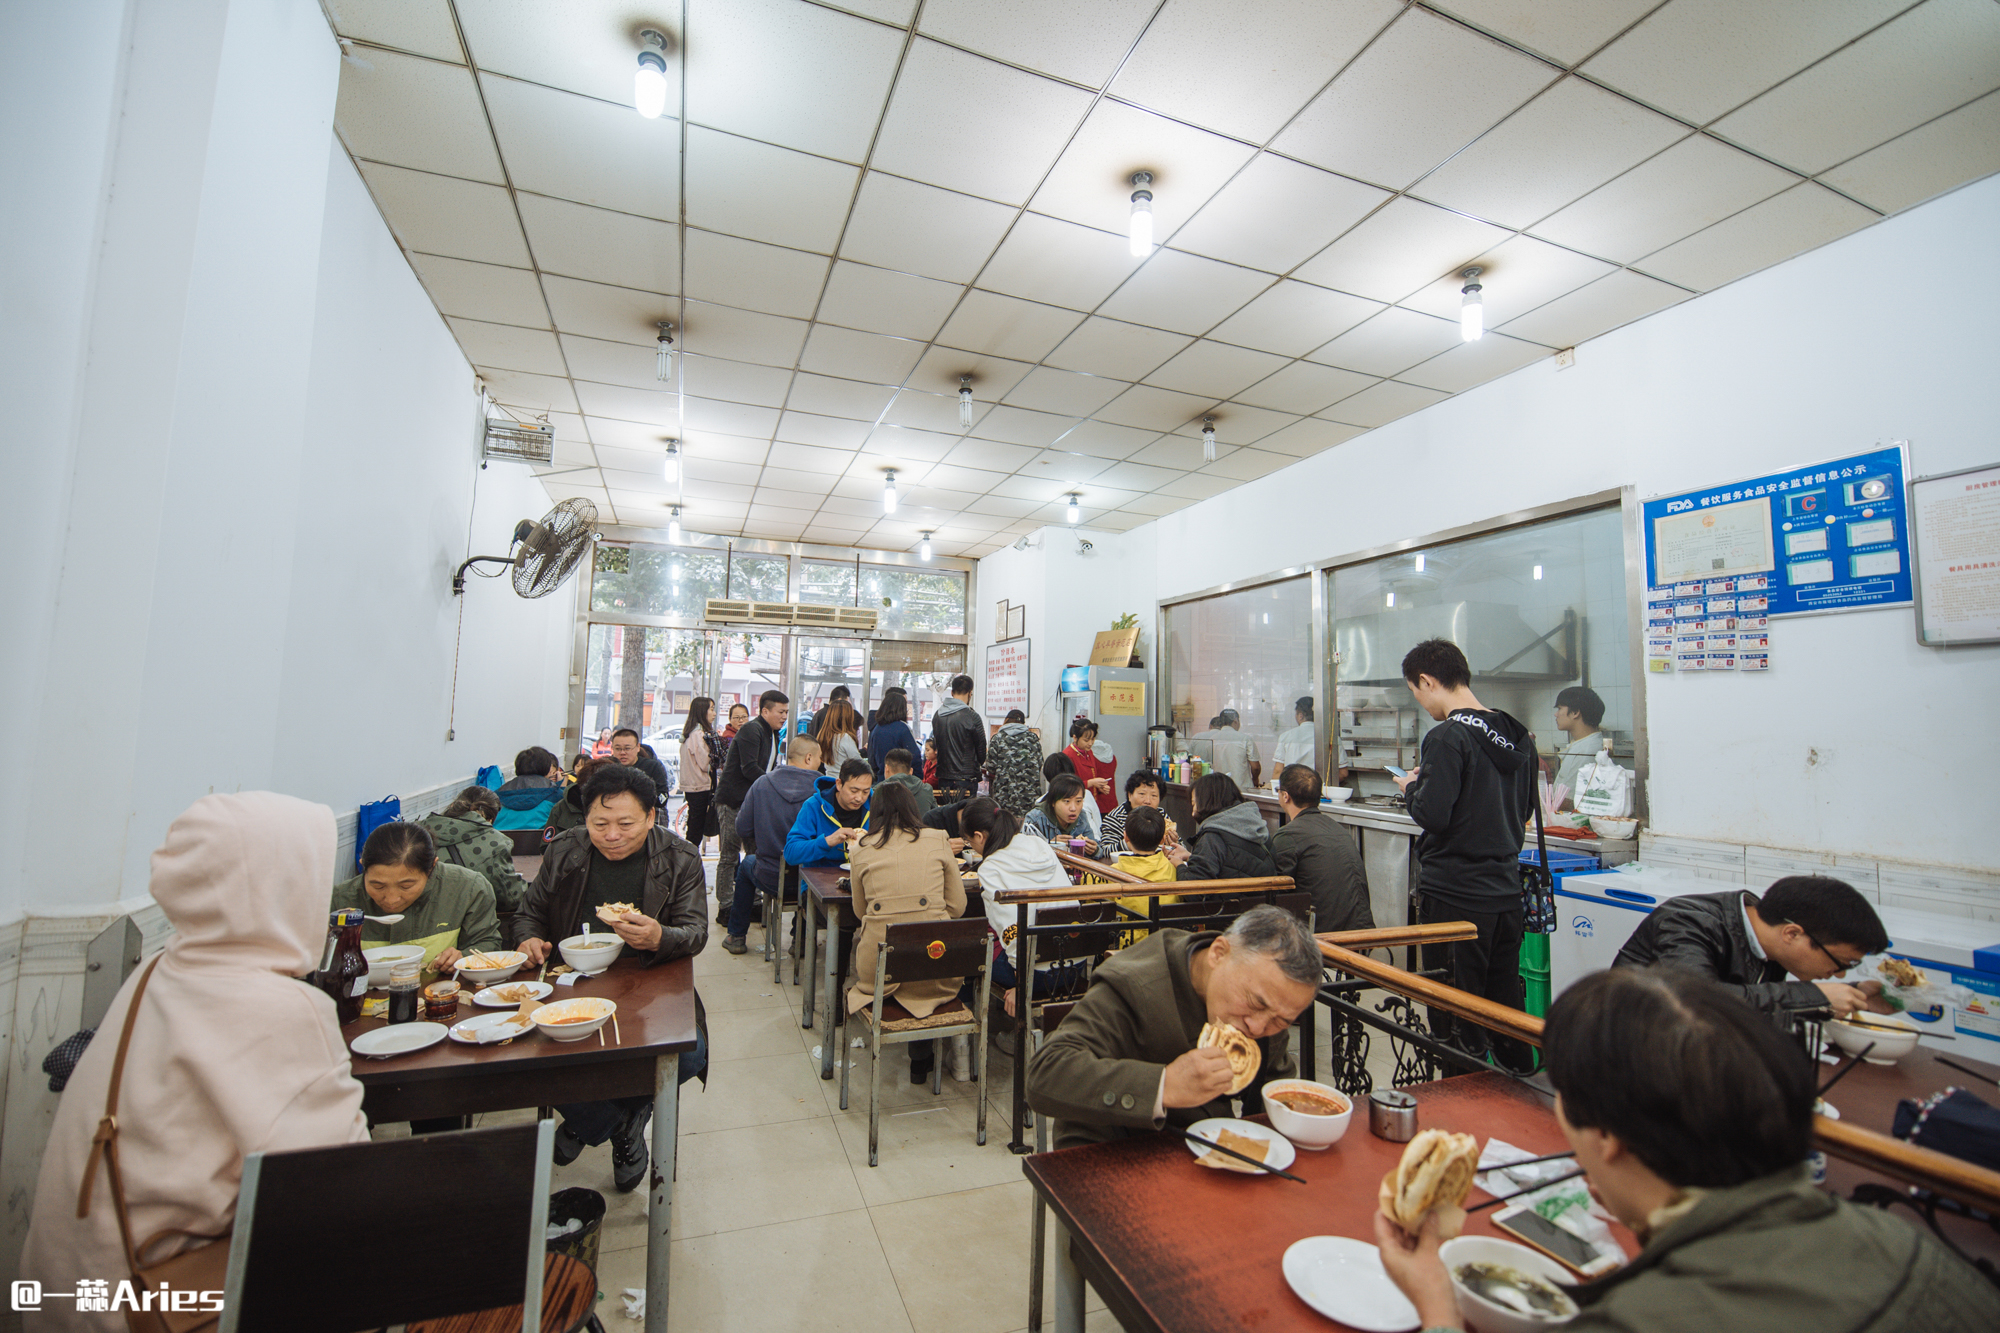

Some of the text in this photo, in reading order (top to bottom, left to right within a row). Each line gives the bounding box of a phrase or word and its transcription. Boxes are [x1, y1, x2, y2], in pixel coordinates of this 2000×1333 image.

[1667, 464, 1867, 513] FDA 餐饮服务食品安全监督信息公示
[1801, 496, 1817, 511] C
[1110, 693, 1134, 703] 示范店
